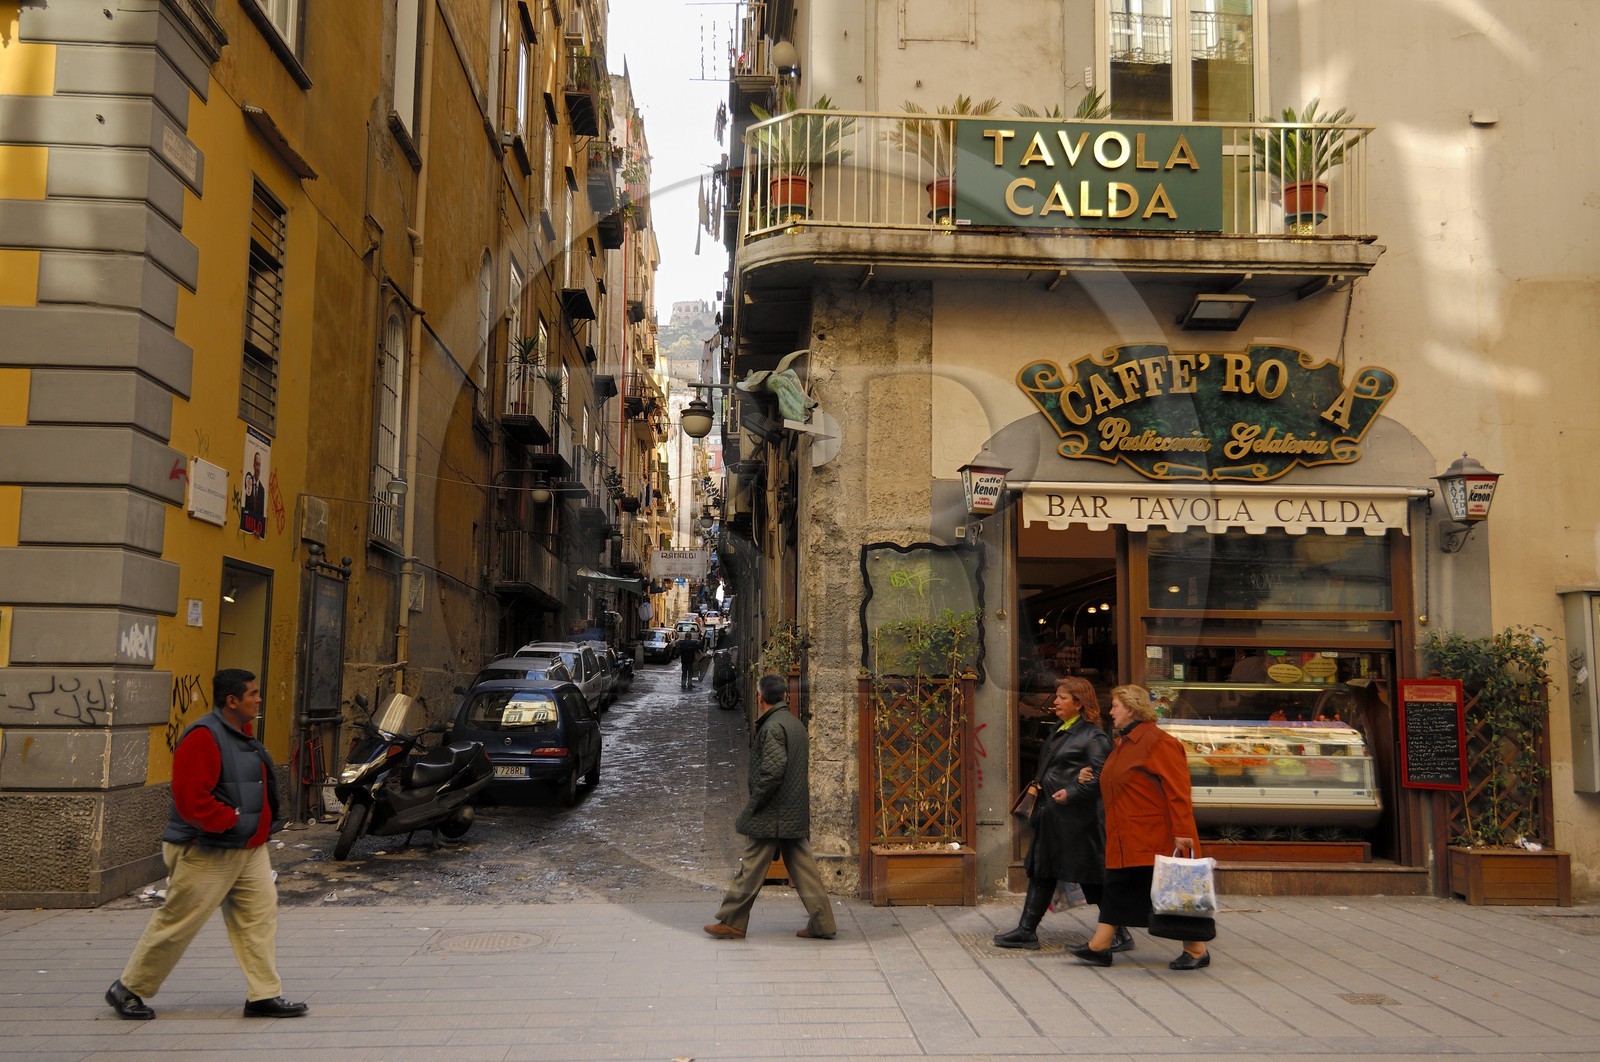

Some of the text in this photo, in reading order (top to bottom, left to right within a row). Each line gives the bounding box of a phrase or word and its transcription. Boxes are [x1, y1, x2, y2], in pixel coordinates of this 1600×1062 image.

[983, 129, 1200, 170] TAVOLA
[1004, 177, 1178, 220] CALDA
[1059, 353, 1352, 431] CAFFE' ROA
[1096, 416, 1330, 461] Pasticceria Gelateria
[1046, 494, 1385, 524] BAR TAVOLA CALDA
[1449, 480, 1459, 516] TAVOLA
[1458, 480, 1466, 515] CALDA
[244, 515, 263, 536] MILO
[500, 766, 525, 776] 728RL
